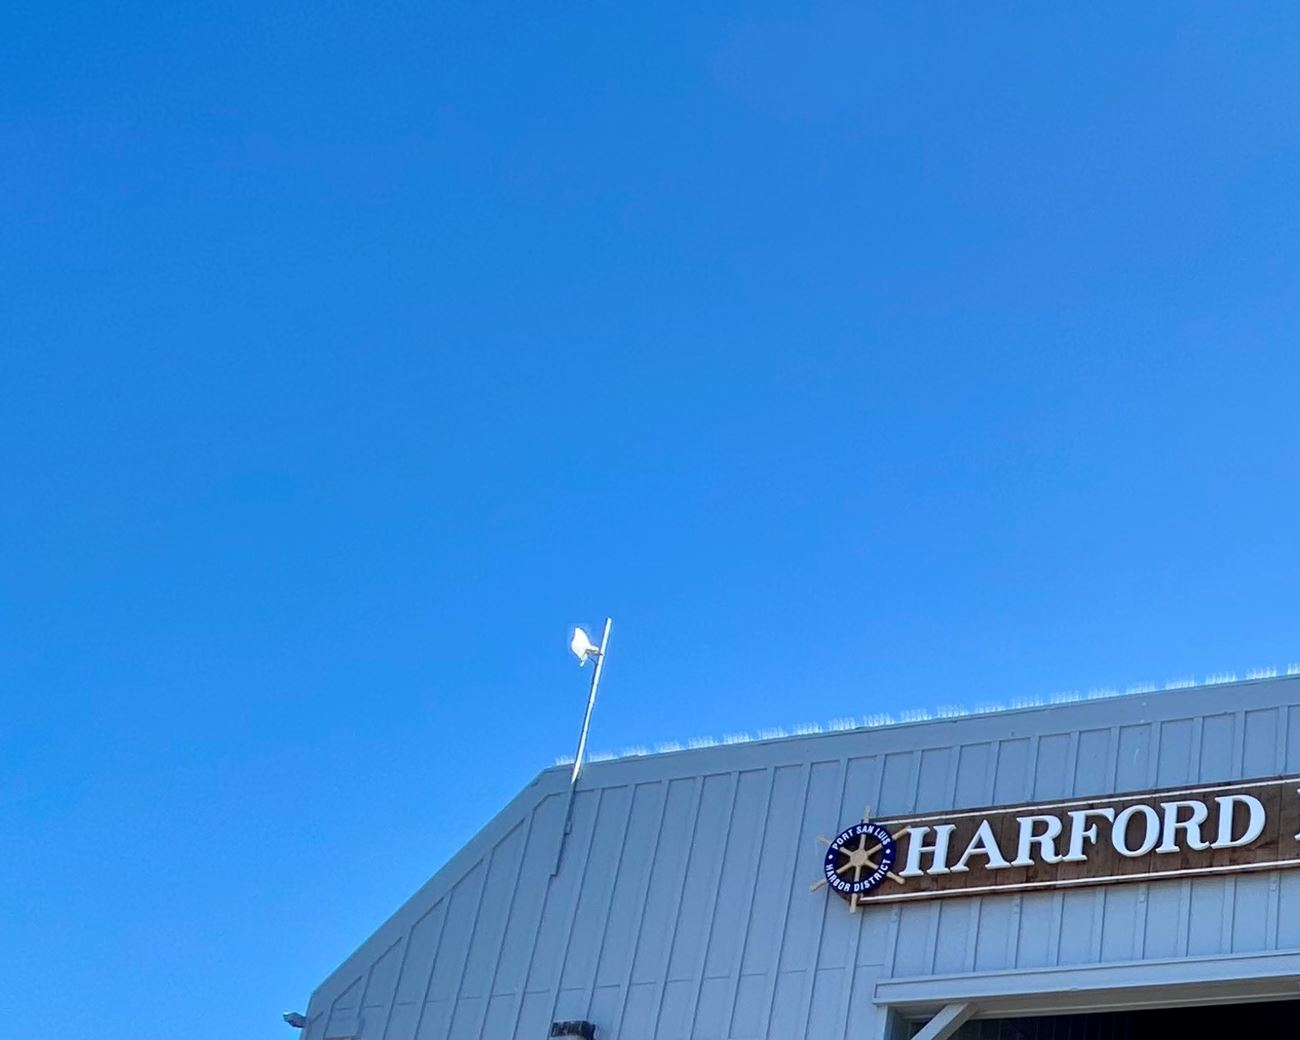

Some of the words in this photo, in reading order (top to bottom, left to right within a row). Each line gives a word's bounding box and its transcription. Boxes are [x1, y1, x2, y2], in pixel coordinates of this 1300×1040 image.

[832, 829, 854, 850] PORT
[856, 825, 874, 834] SAN
[874, 828, 891, 845] LUIS
[900, 794, 1265, 877] HARFORD
[826, 863, 851, 892] HARBOR
[854, 859, 891, 892] DISTRICT
